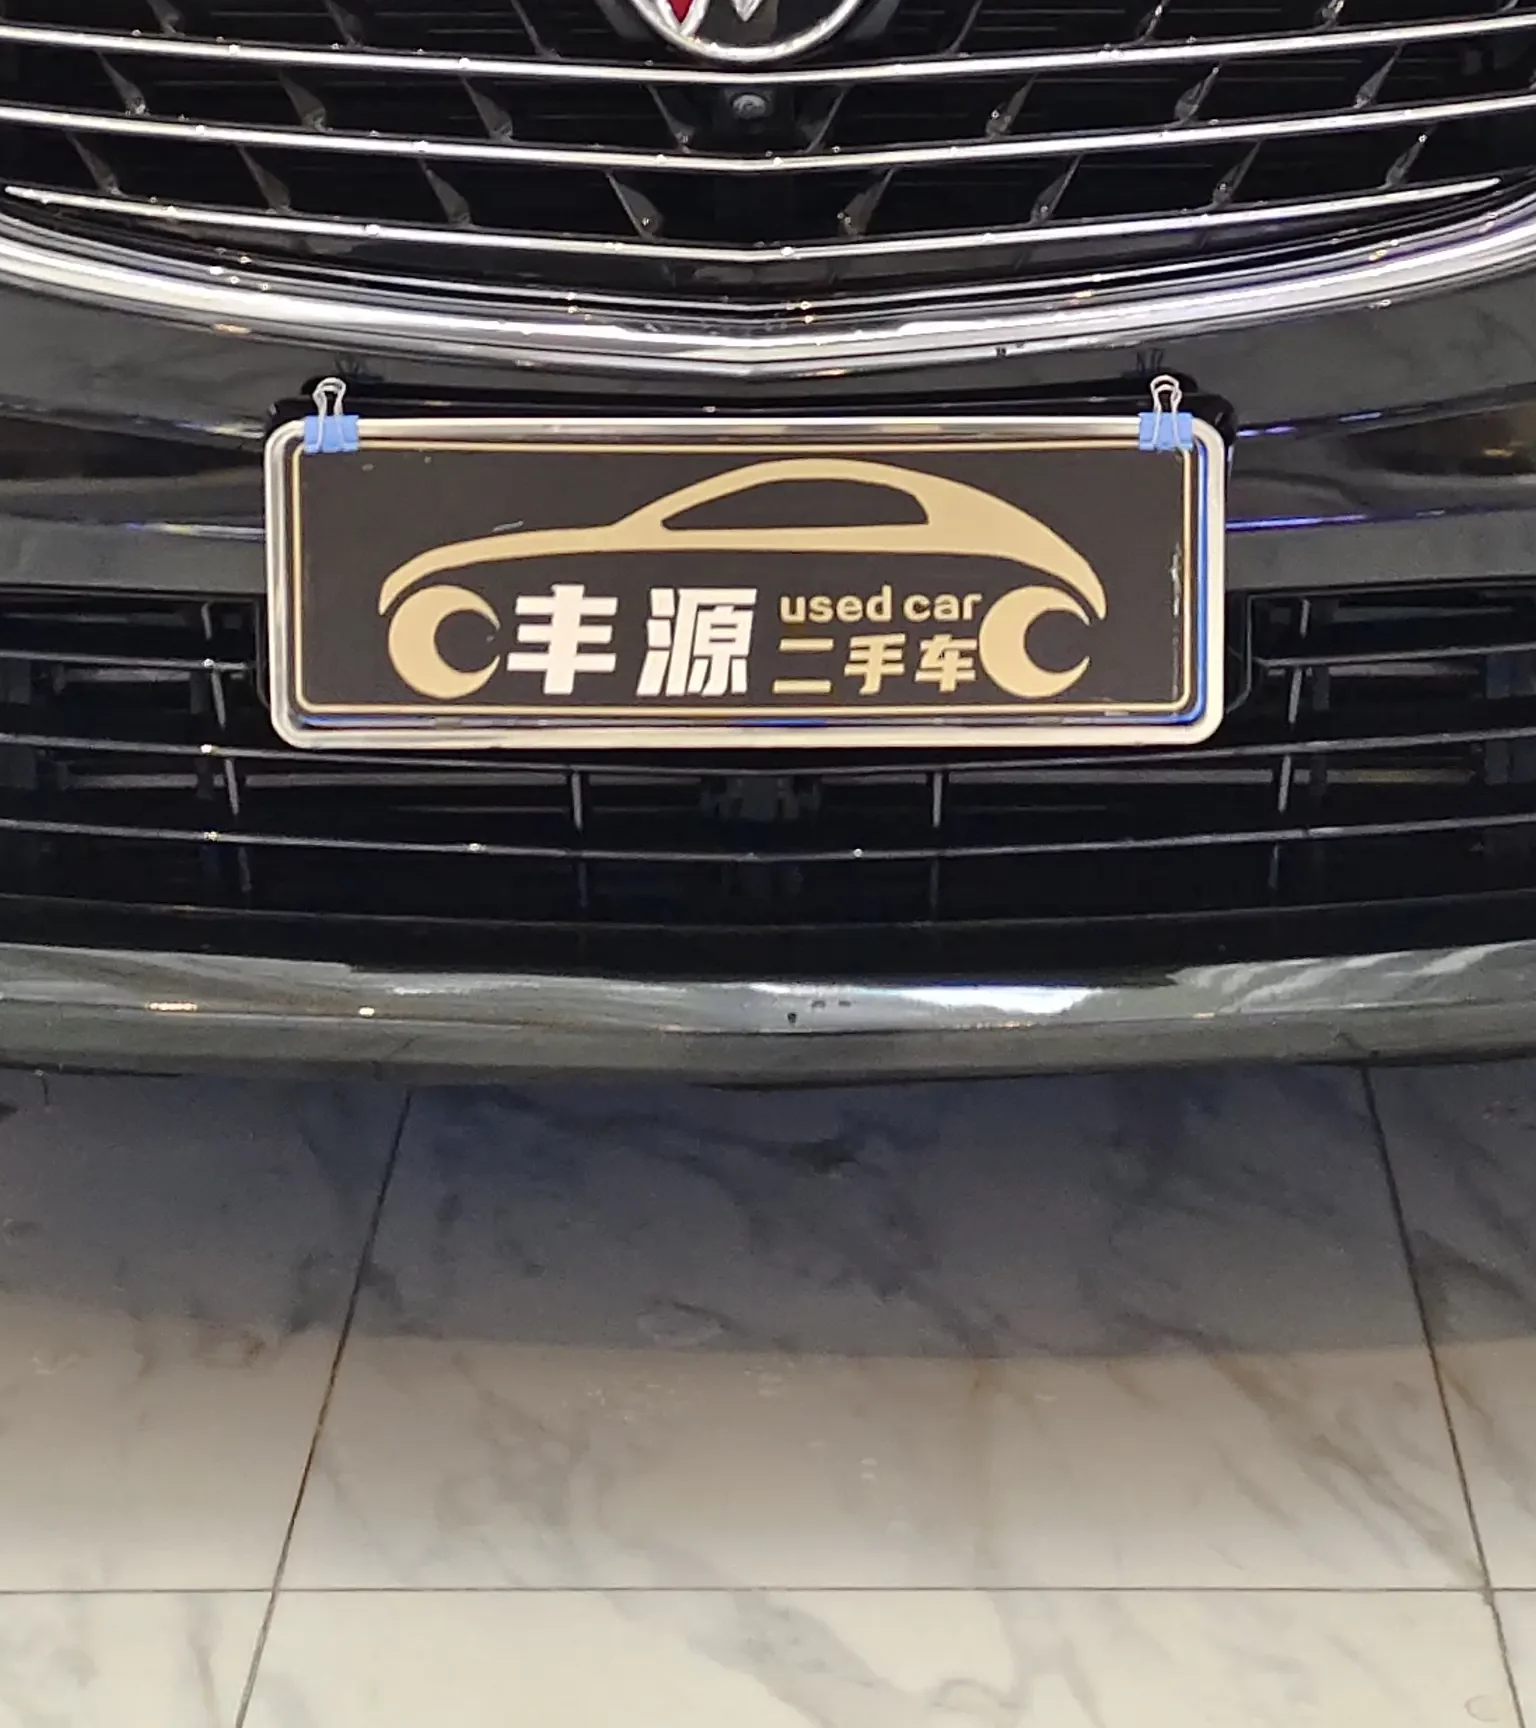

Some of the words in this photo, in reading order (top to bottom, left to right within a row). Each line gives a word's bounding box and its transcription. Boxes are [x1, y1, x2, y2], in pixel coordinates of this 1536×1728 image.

[779, 583, 892, 624] used
[902, 590, 982, 621] car
[772, 633, 979, 696] 二手车
